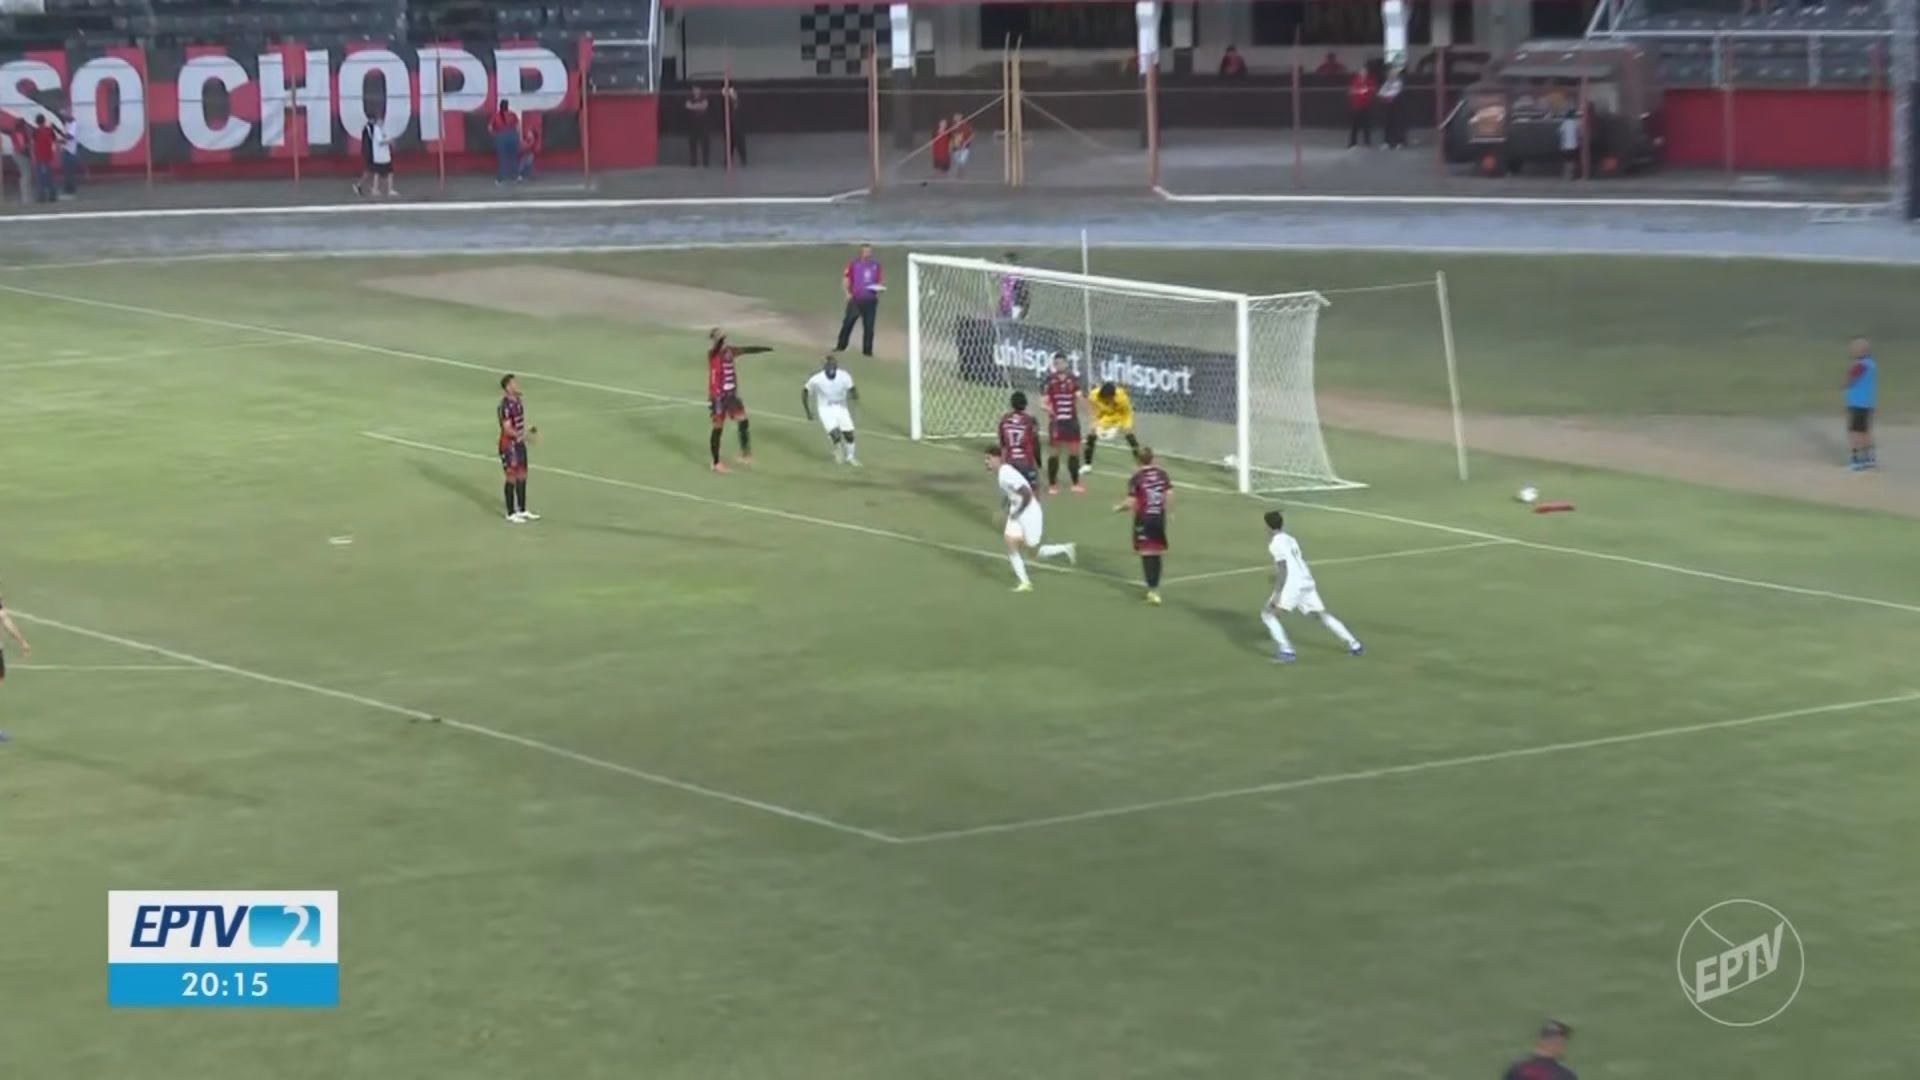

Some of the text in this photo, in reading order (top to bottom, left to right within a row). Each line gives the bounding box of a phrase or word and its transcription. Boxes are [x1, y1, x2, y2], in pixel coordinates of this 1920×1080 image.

[177, 48, 568, 151] CHOPP
[1101, 354, 1192, 394] uhlsport
[1006, 429, 1024, 447] 17
